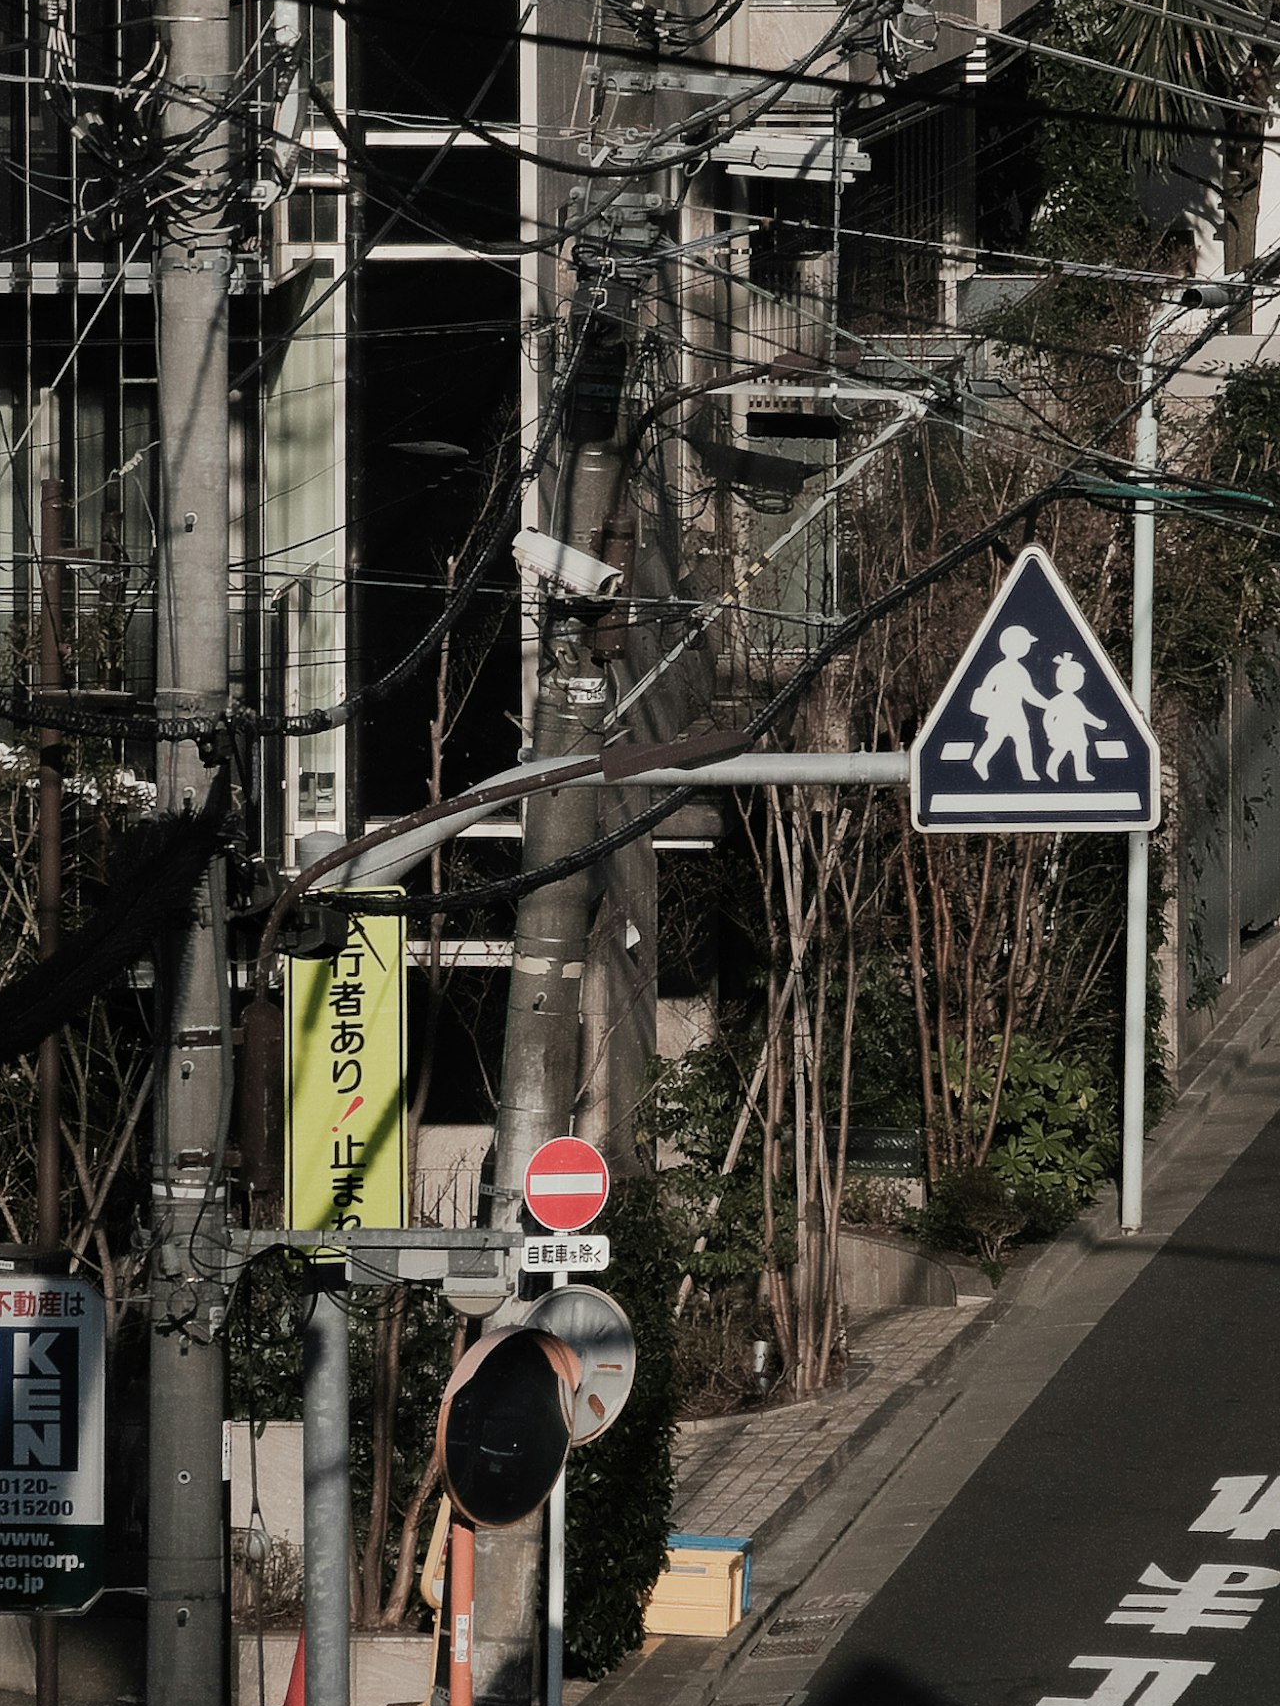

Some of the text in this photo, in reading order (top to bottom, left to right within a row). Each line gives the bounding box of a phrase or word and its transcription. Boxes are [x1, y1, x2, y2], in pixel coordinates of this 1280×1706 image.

[527, 1244, 601, 1265] 自転車を除く
[12, 1331, 62, 1468] KEN
